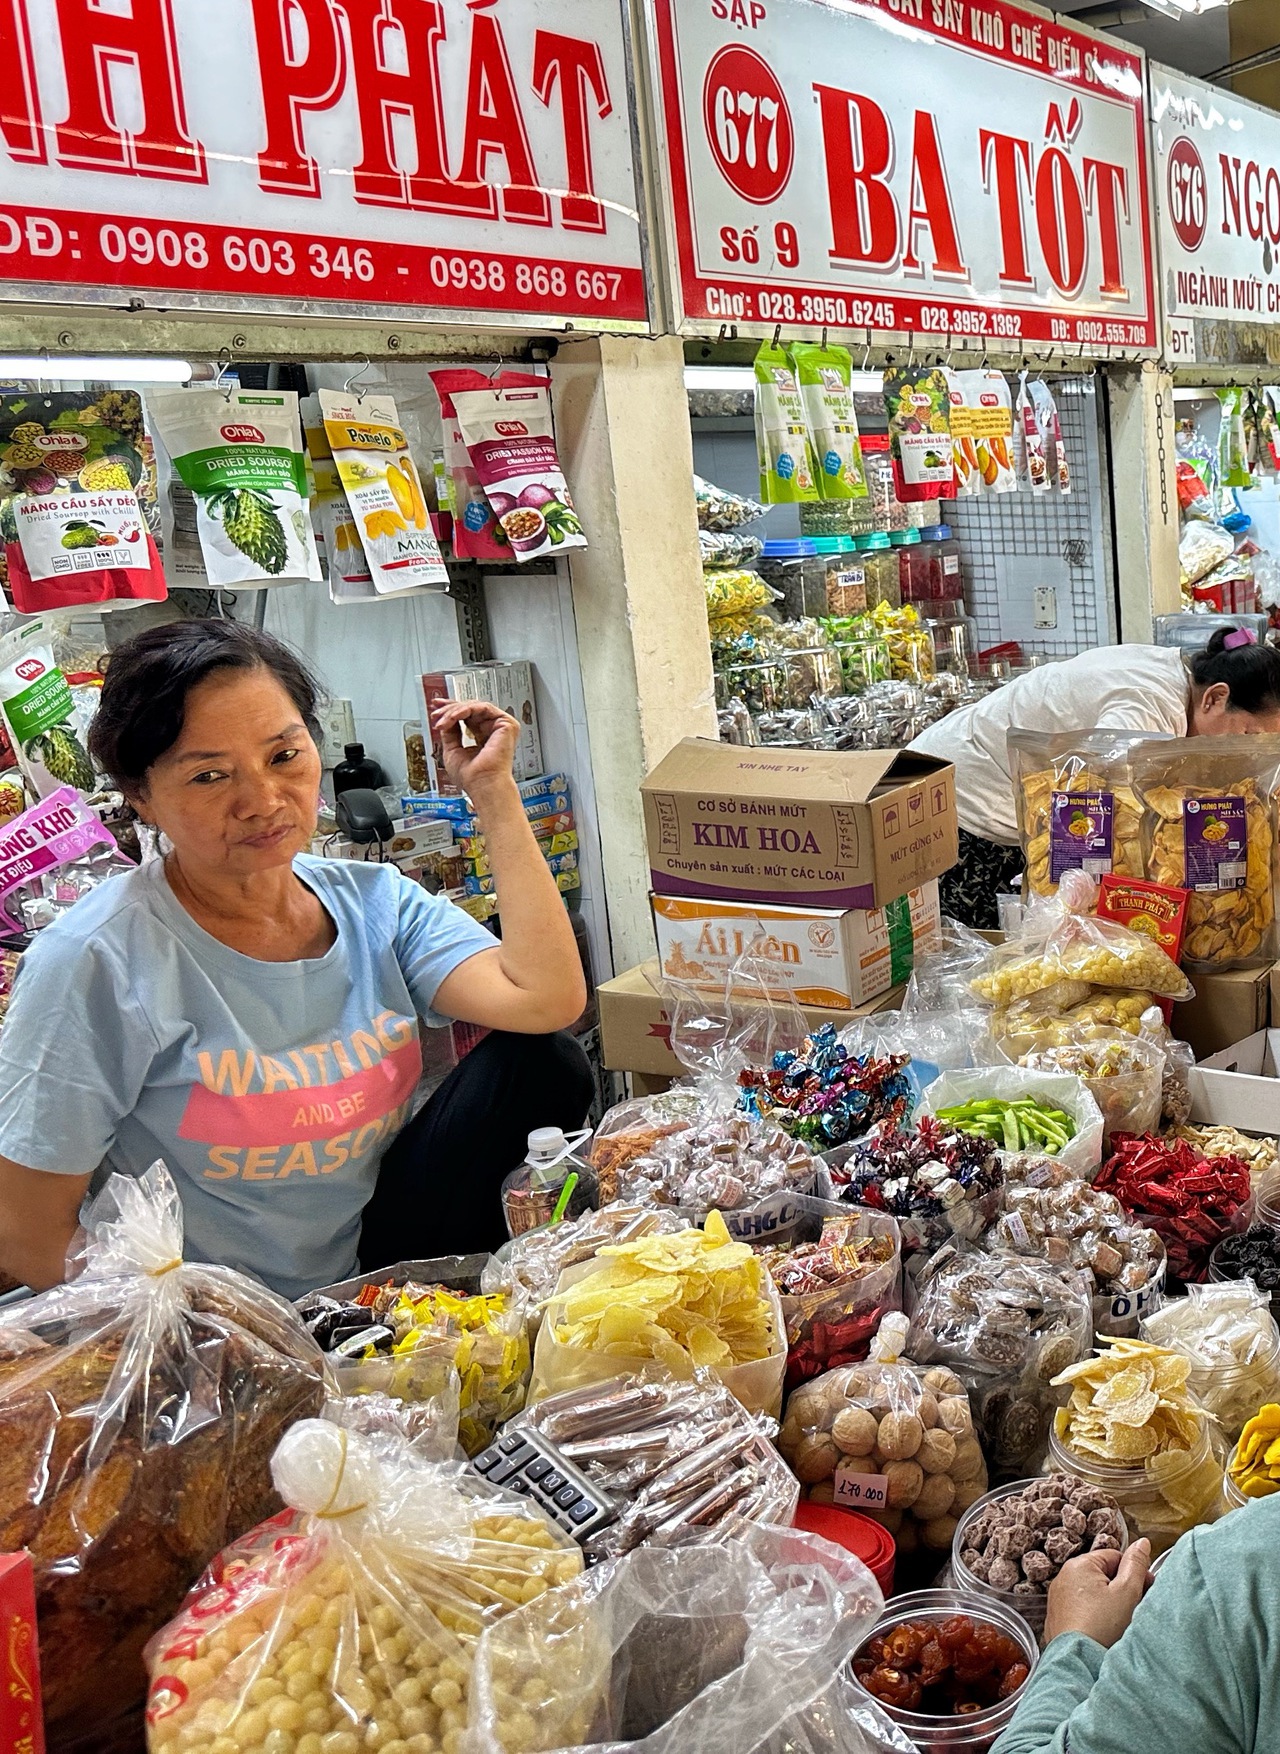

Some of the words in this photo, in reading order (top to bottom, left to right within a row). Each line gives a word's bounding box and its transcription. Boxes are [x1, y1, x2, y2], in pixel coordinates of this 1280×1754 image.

[971, 7, 1005, 51] KHÔ
[1011, 23, 1043, 65] CHẾ
[1047, 36, 1080, 78] BIẾN
[715, 86, 780, 175] 677
[812, 82, 969, 284] BA
[979, 97, 1131, 302] TỐT
[1171, 159, 1206, 228] 676
[720, 223, 760, 265] Số
[774, 221, 800, 268] 9
[100, 223, 210, 270] 0908
[223, 239, 296, 278] 603
[309, 244, 376, 283] 346
[429, 255, 505, 293] 0938
[515, 262, 567, 297] 868
[575, 267, 623, 301] 667
[1177, 266, 1229, 307] NGÀNH
[1232, 273, 1263, 313] MỨT
[706, 287, 753, 323] Chợ:
[758, 291, 896, 329] 028.3950.6245
[920, 305, 1023, 337] 028.3952.1362
[1051, 320, 1071, 340] DĐ:
[1076, 322, 1147, 346] 0902.555.709
[1172, 329, 1195, 355] ĐT:
[224, 426, 254, 438] Ohla
[346, 428, 392, 446] Pomelo
[206, 457, 246, 471] DRIED
[511, 446, 543, 457] PASSION
[20, 502, 58, 516] MÃNG
[61, 497, 88, 510] CẦU
[91, 495, 115, 508] SẤY
[116, 494, 137, 507] DẺO
[354, 491, 369, 500] XOÀI
[26, 512, 52, 524] Dried
[53, 510, 89, 521] Soursop
[91, 507, 111, 517] with
[112, 506, 135, 516] Chilli
[22, 694, 47, 715] DRIED
[736, 762, 757, 771] XIN
[758, 762, 785, 774] NHẸ
[786, 764, 810, 774] TAY
[697, 800, 717, 812] CƠ
[719, 798, 737, 814] SỞ
[740, 801, 776, 817] BÁNH
[780, 803, 808, 818] MỨT
[1200, 802, 1218, 811] HƯNG
[1218, 801, 1233, 811] PHÁT
[32, 802, 79, 841] KHÔ
[691, 822, 750, 850] KIM
[756, 827, 822, 855] HOA
[667, 858, 707, 872] Chuyên
[709, 860, 729, 873] sản
[731, 862, 755, 875] xuất
[764, 864, 788, 877] MỨT
[790, 865, 815, 880] CÁC
[818, 869, 845, 883] LOẠI
[696, 921, 728, 955] Ái
[197, 1010, 413, 1097] WAITING
[292, 1104, 335, 1129] AND
[336, 1090, 366, 1120] BE
[837, 1479, 884, 1501] 170.000
